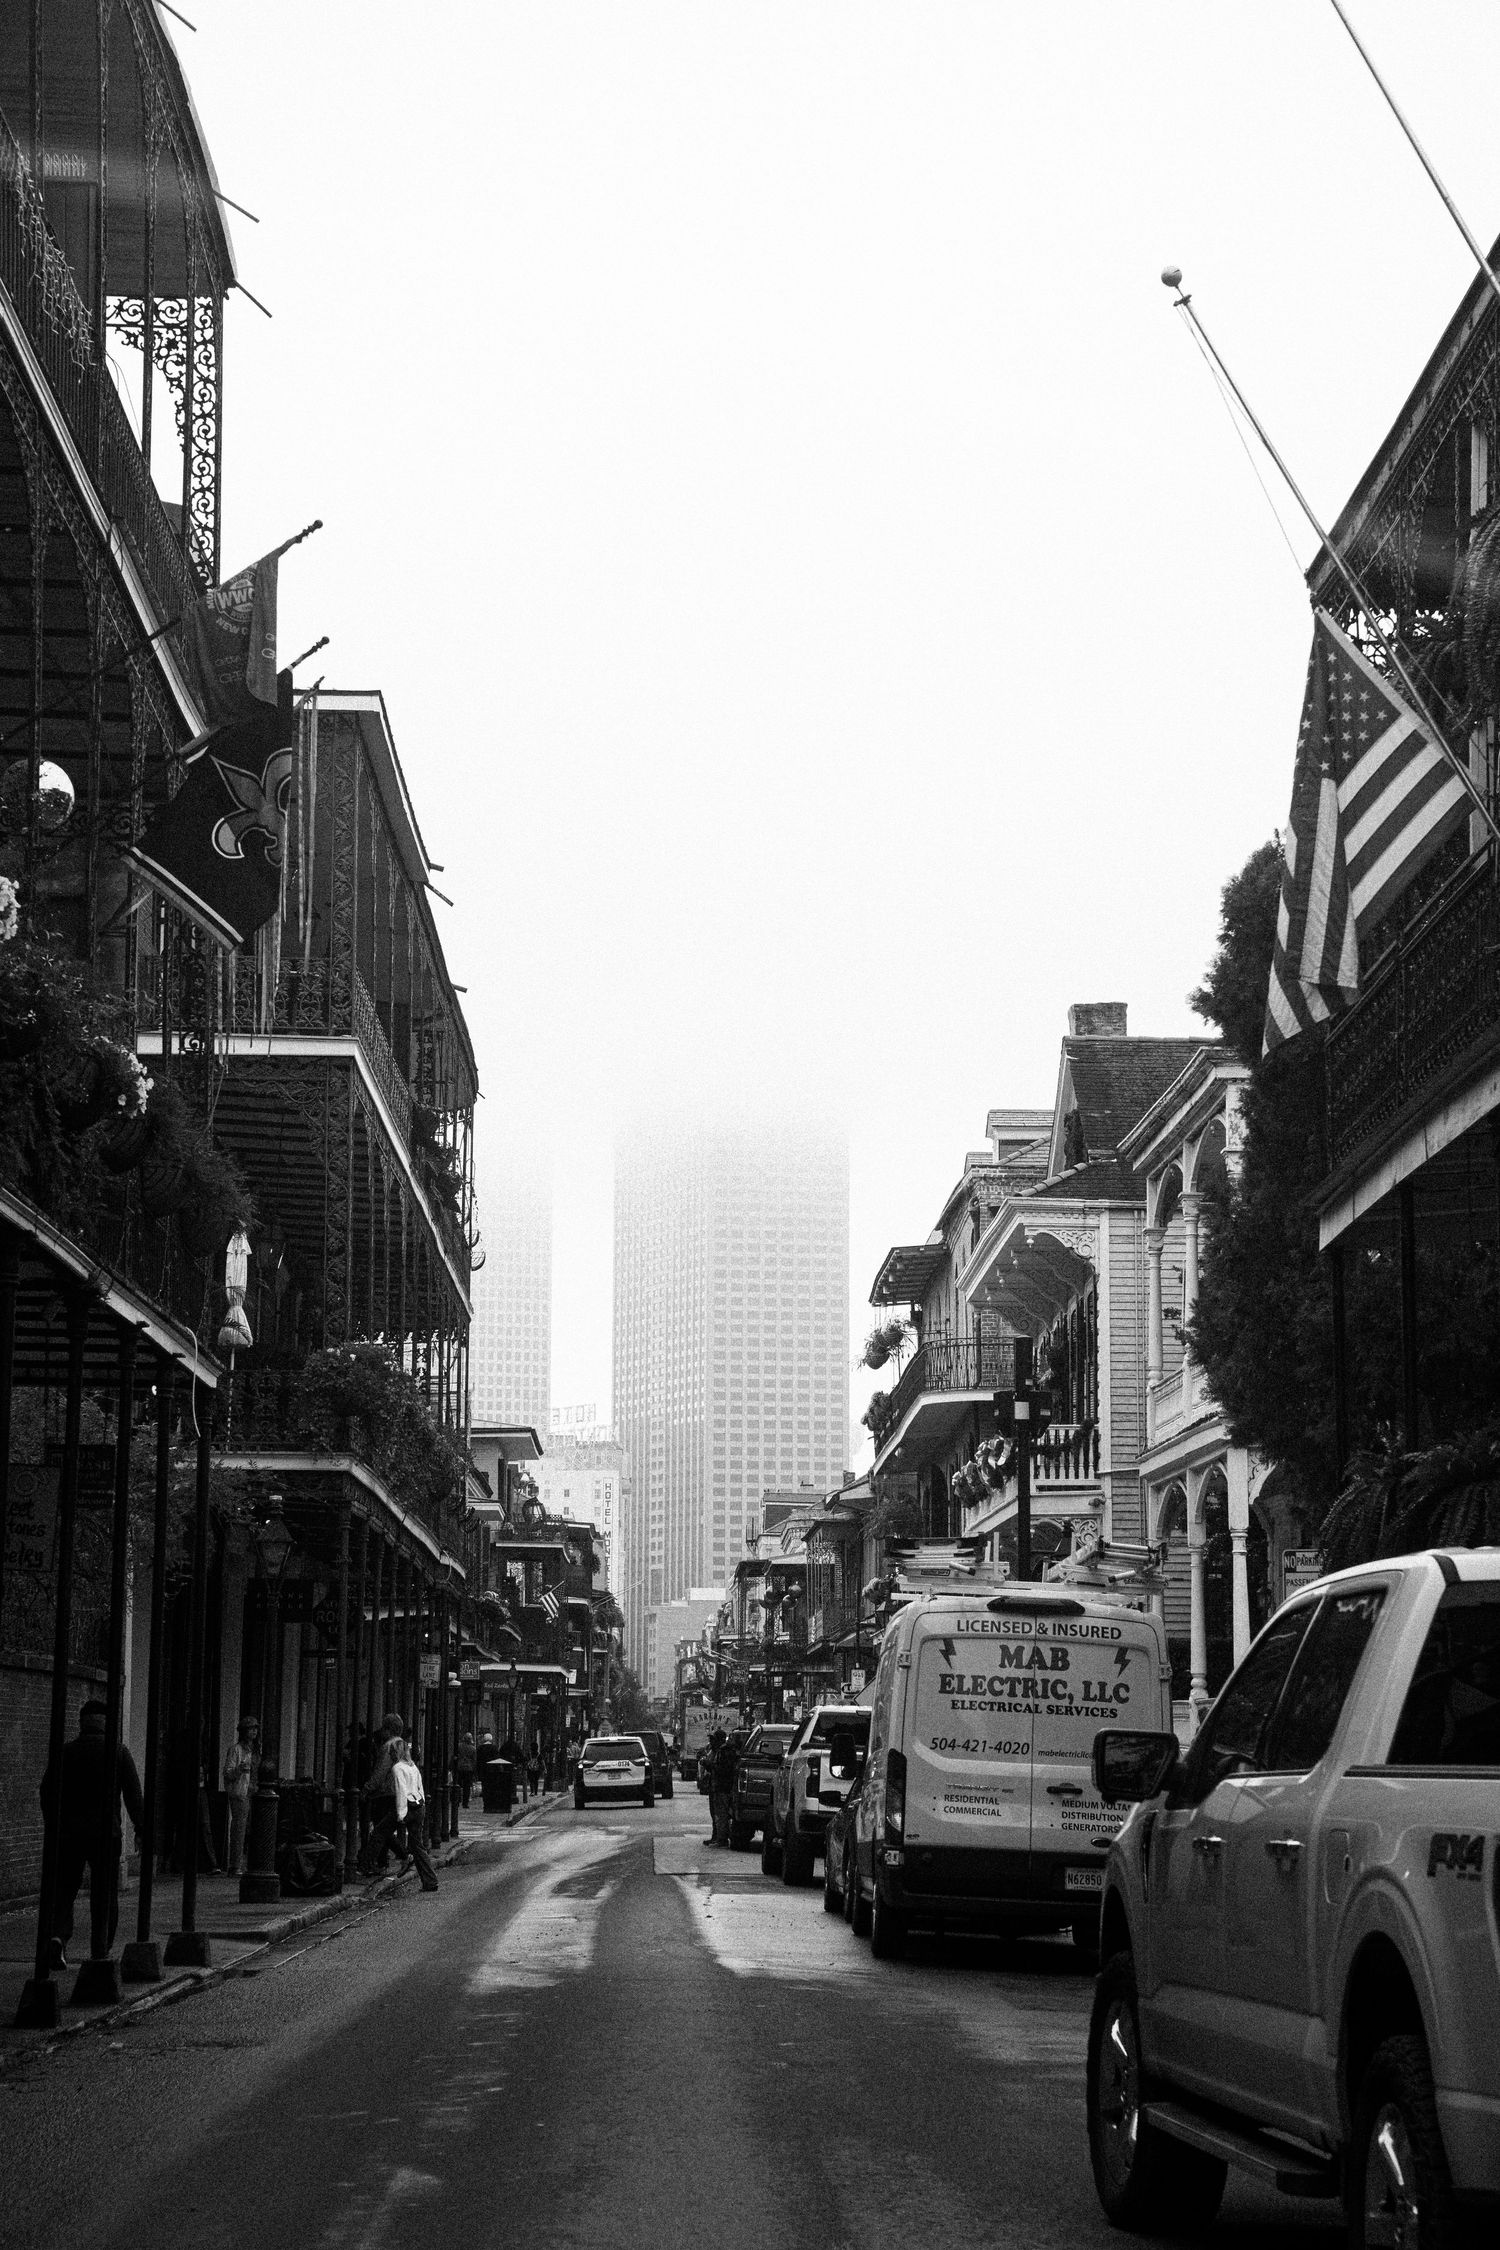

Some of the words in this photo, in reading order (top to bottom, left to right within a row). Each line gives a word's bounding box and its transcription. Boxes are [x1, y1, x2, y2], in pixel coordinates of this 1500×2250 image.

[604, 1482, 612, 1525] HOTEL
[1284, 1555, 1296, 1569] NO
[957, 1619, 1033, 1634] LICENSED
[1037, 1623, 1049, 1635] &
[1052, 1623, 1122, 1640] INSURED
[998, 1644, 1071, 1672] MAB
[938, 1673, 1074, 1705] ELECTRIC,
[1081, 1680, 1131, 1704] LLC
[950, 1699, 1043, 1714] ELECTRICAL
[1045, 1704, 1118, 1719] SERVICES
[929, 1737, 1030, 1755] 504-421-4020
[944, 1794, 1000, 1805] RESIDENTIAL
[1061, 1799, 1099, 1810] MEDIUM
[943, 1805, 1002, 1817] COMMERCIAL
[1061, 1811, 1124, 1822] DISTRIBUTION
[1061, 1822, 1119, 1834] GENERATORS
